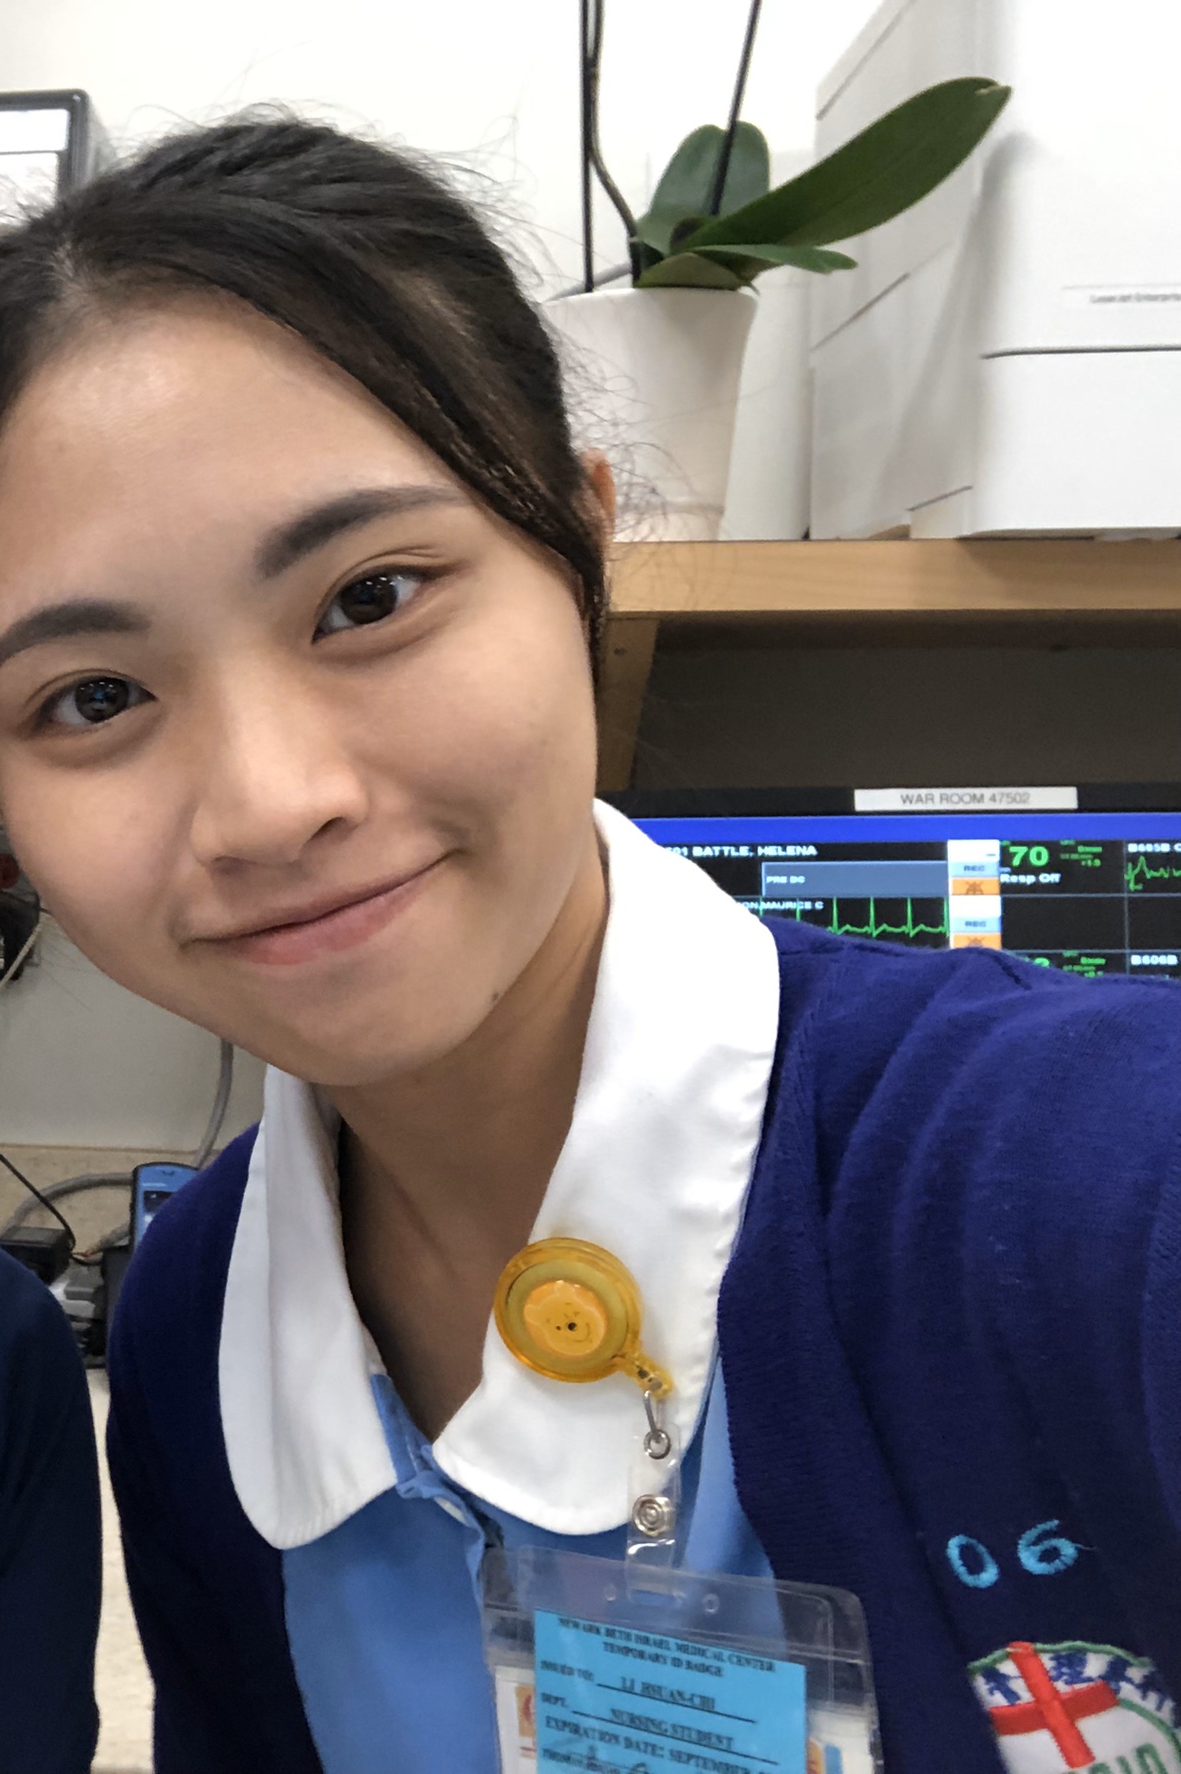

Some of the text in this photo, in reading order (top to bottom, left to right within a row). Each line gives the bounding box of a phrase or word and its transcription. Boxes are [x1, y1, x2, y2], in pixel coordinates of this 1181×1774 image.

[900, 791, 1031, 805] WAR ROOM 47502
[757, 845, 819, 856] HELENA
[1009, 846, 1049, 868] 70
[1000, 873, 1062, 886] Resp Off
[602, 1641, 723, 1678] TEMPORARY ID BADGE
[675, 1642, 725, 1663] MEDICAL
[727, 1652, 776, 1673] CENTER
[545, 1715, 621, 1746] EXPIRATION
[610, 1708, 734, 1750] NURSING STUDENT
